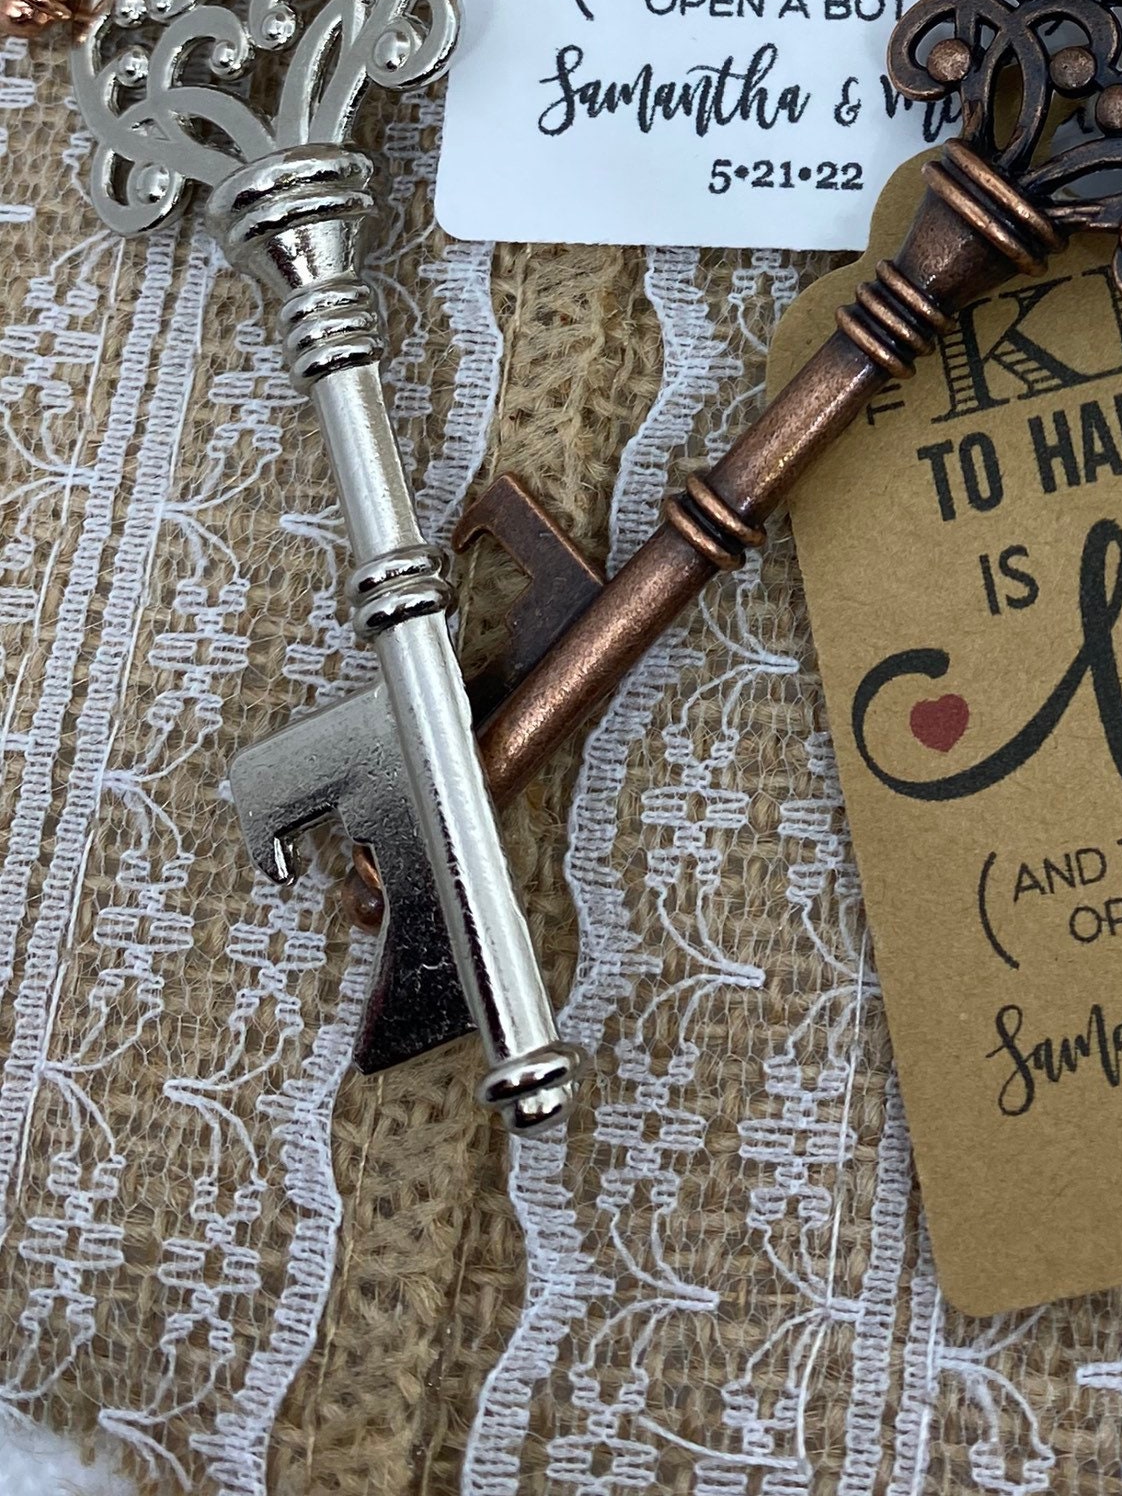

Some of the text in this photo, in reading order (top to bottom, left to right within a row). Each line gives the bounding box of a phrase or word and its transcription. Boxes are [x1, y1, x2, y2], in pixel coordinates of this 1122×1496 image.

[537, 41, 812, 139] Samantha
[832, 75, 863, 128] &
[917, 430, 1004, 522] TO
[979, 544, 1040, 616] IS
